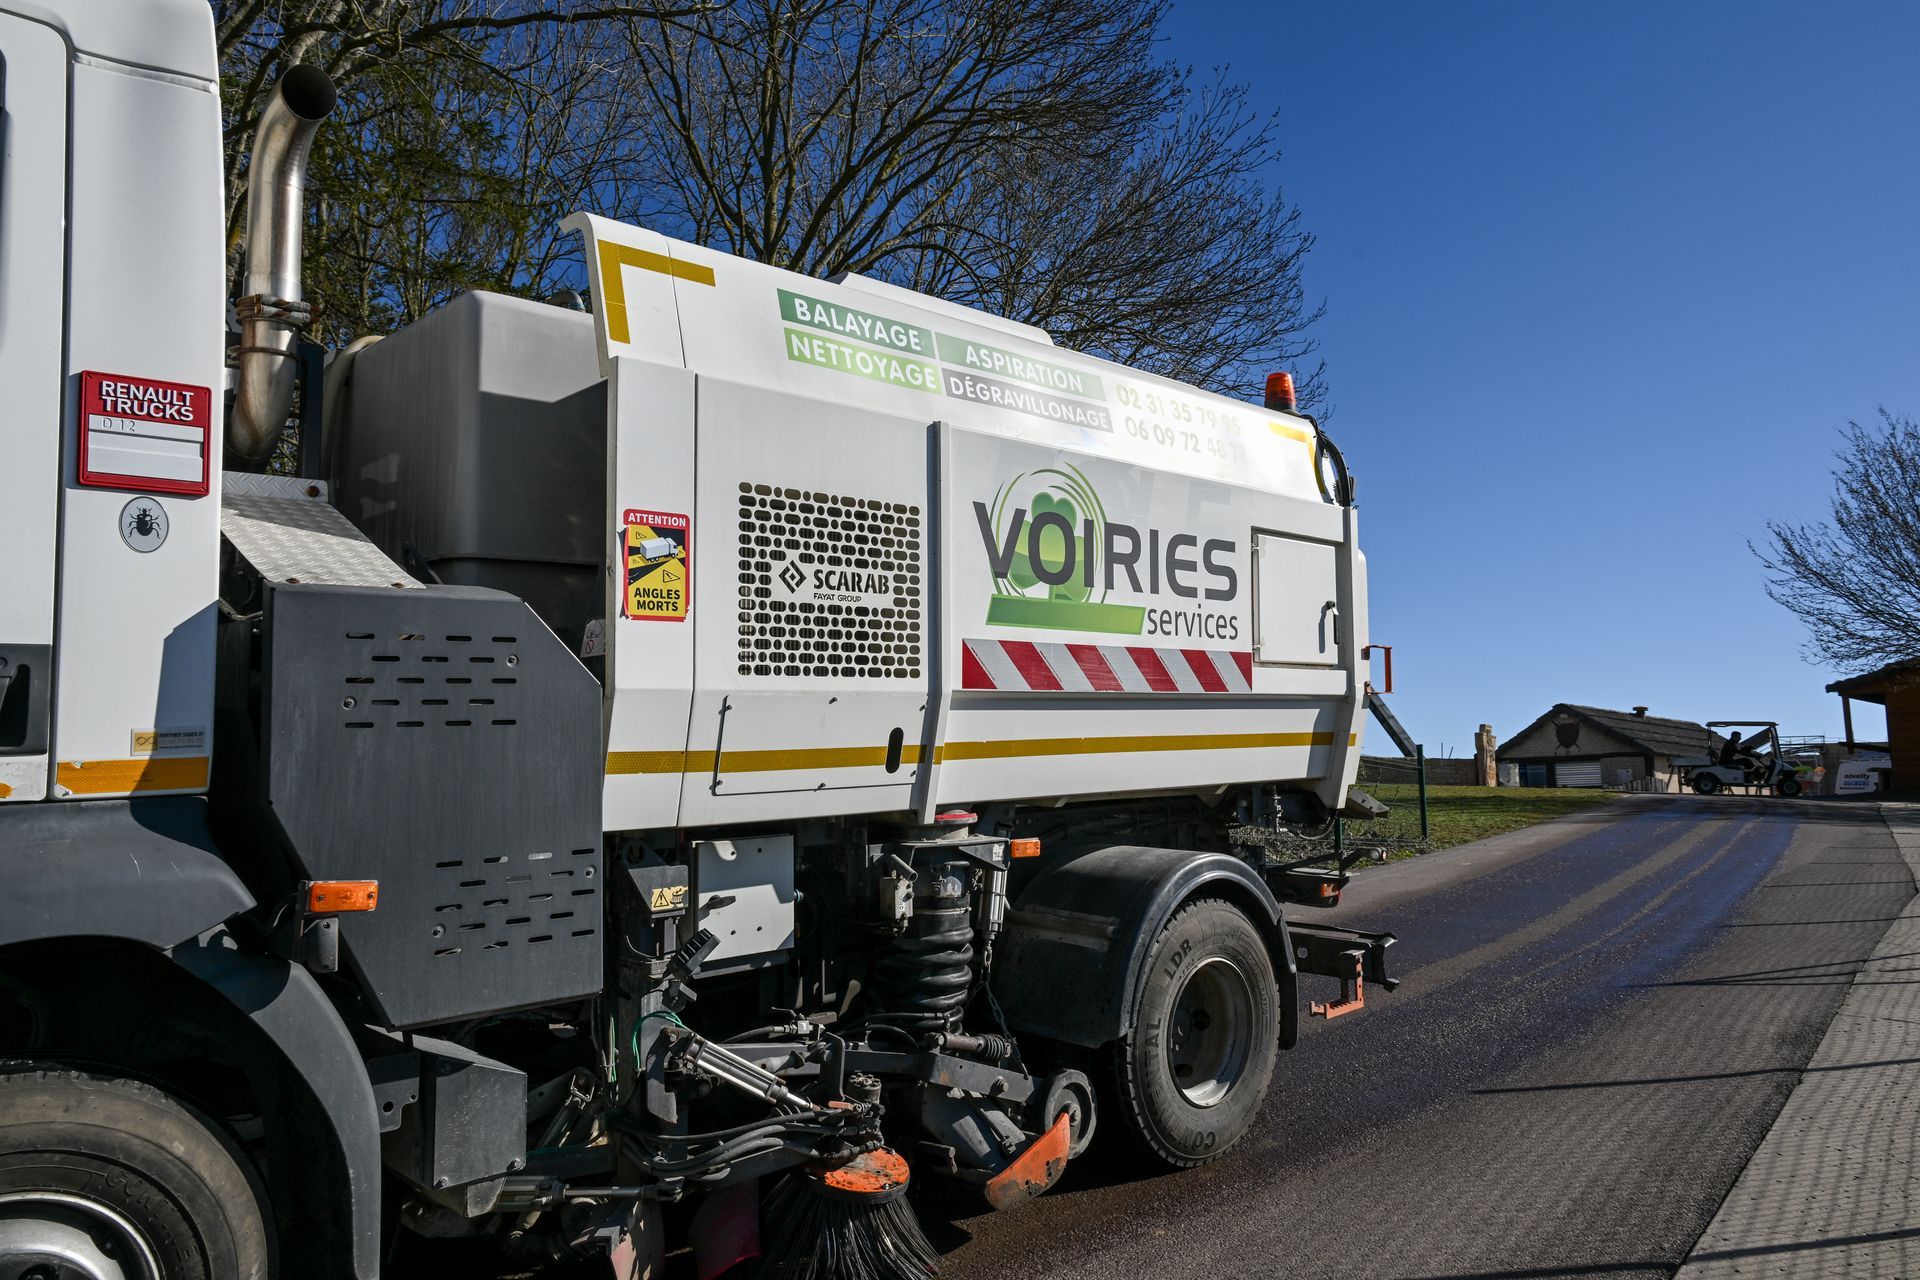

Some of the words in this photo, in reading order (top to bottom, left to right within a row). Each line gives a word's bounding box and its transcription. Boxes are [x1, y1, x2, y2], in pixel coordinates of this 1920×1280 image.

[794, 298, 922, 351] BALAYAGE
[790, 333, 937, 389] NETTOYAGE
[966, 345, 1083, 393] ASPIRATION
[101, 396, 194, 421] TRUCKS
[102, 381, 194, 406] RENAULT
[950, 376, 1109, 428] DÉGRAVILLONAGE
[1116, 384, 1142, 410] 02
[1147, 393, 1165, 415] 31
[1171, 400, 1192, 423] 35
[1195, 407, 1217, 429] 79
[1125, 416, 1149, 441] 06
[1153, 424, 1176, 448] 09
[1181, 432, 1202, 453] 72
[628, 513, 686, 527] ATTENTION
[973, 501, 1238, 601] VOIRIES
[634, 588, 681, 600] ANGLES
[813, 569, 890, 595] SCARAB
[814, 593, 835, 601] FAYAT
[837, 594, 862, 603] GROUP
[637, 600, 679, 612] MORTS
[1147, 604, 1239, 640] services
